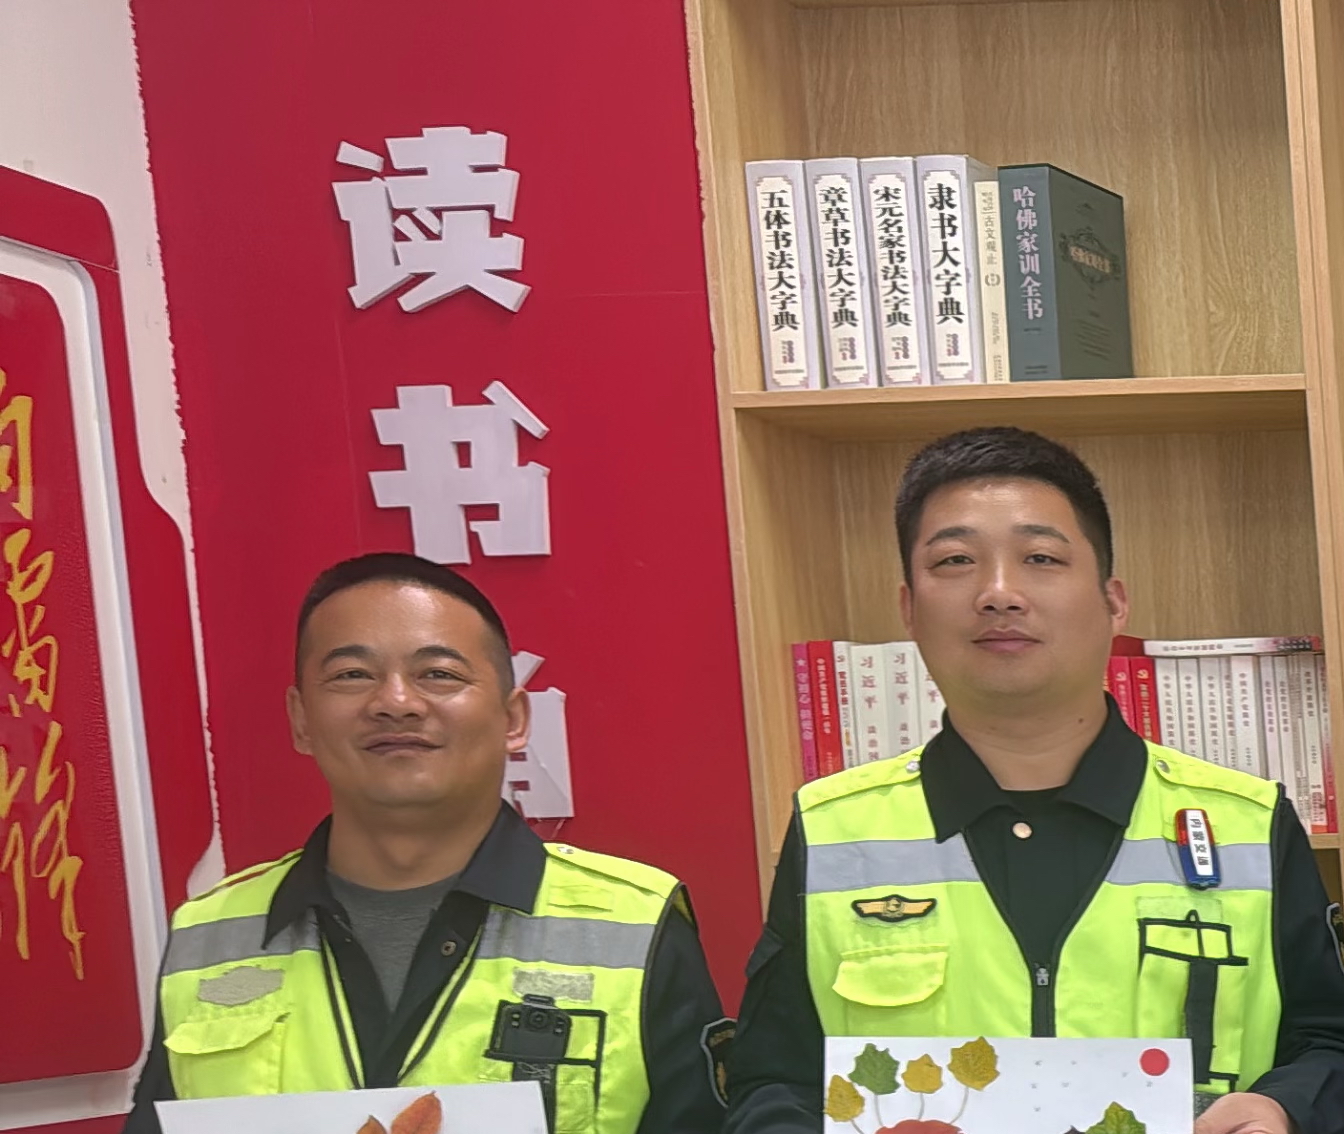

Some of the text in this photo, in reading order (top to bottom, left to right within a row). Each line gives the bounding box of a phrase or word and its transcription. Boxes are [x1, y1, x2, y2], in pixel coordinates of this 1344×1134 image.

[760, 189, 801, 332] 五体书法大字典
[819, 186, 860, 329] 章草书法大字典
[873, 186, 913, 328] 宋元名家书法大字典
[928, 183, 965, 325] 隶书大字典
[1012, 185, 1044, 320] 哈佛家训全书
